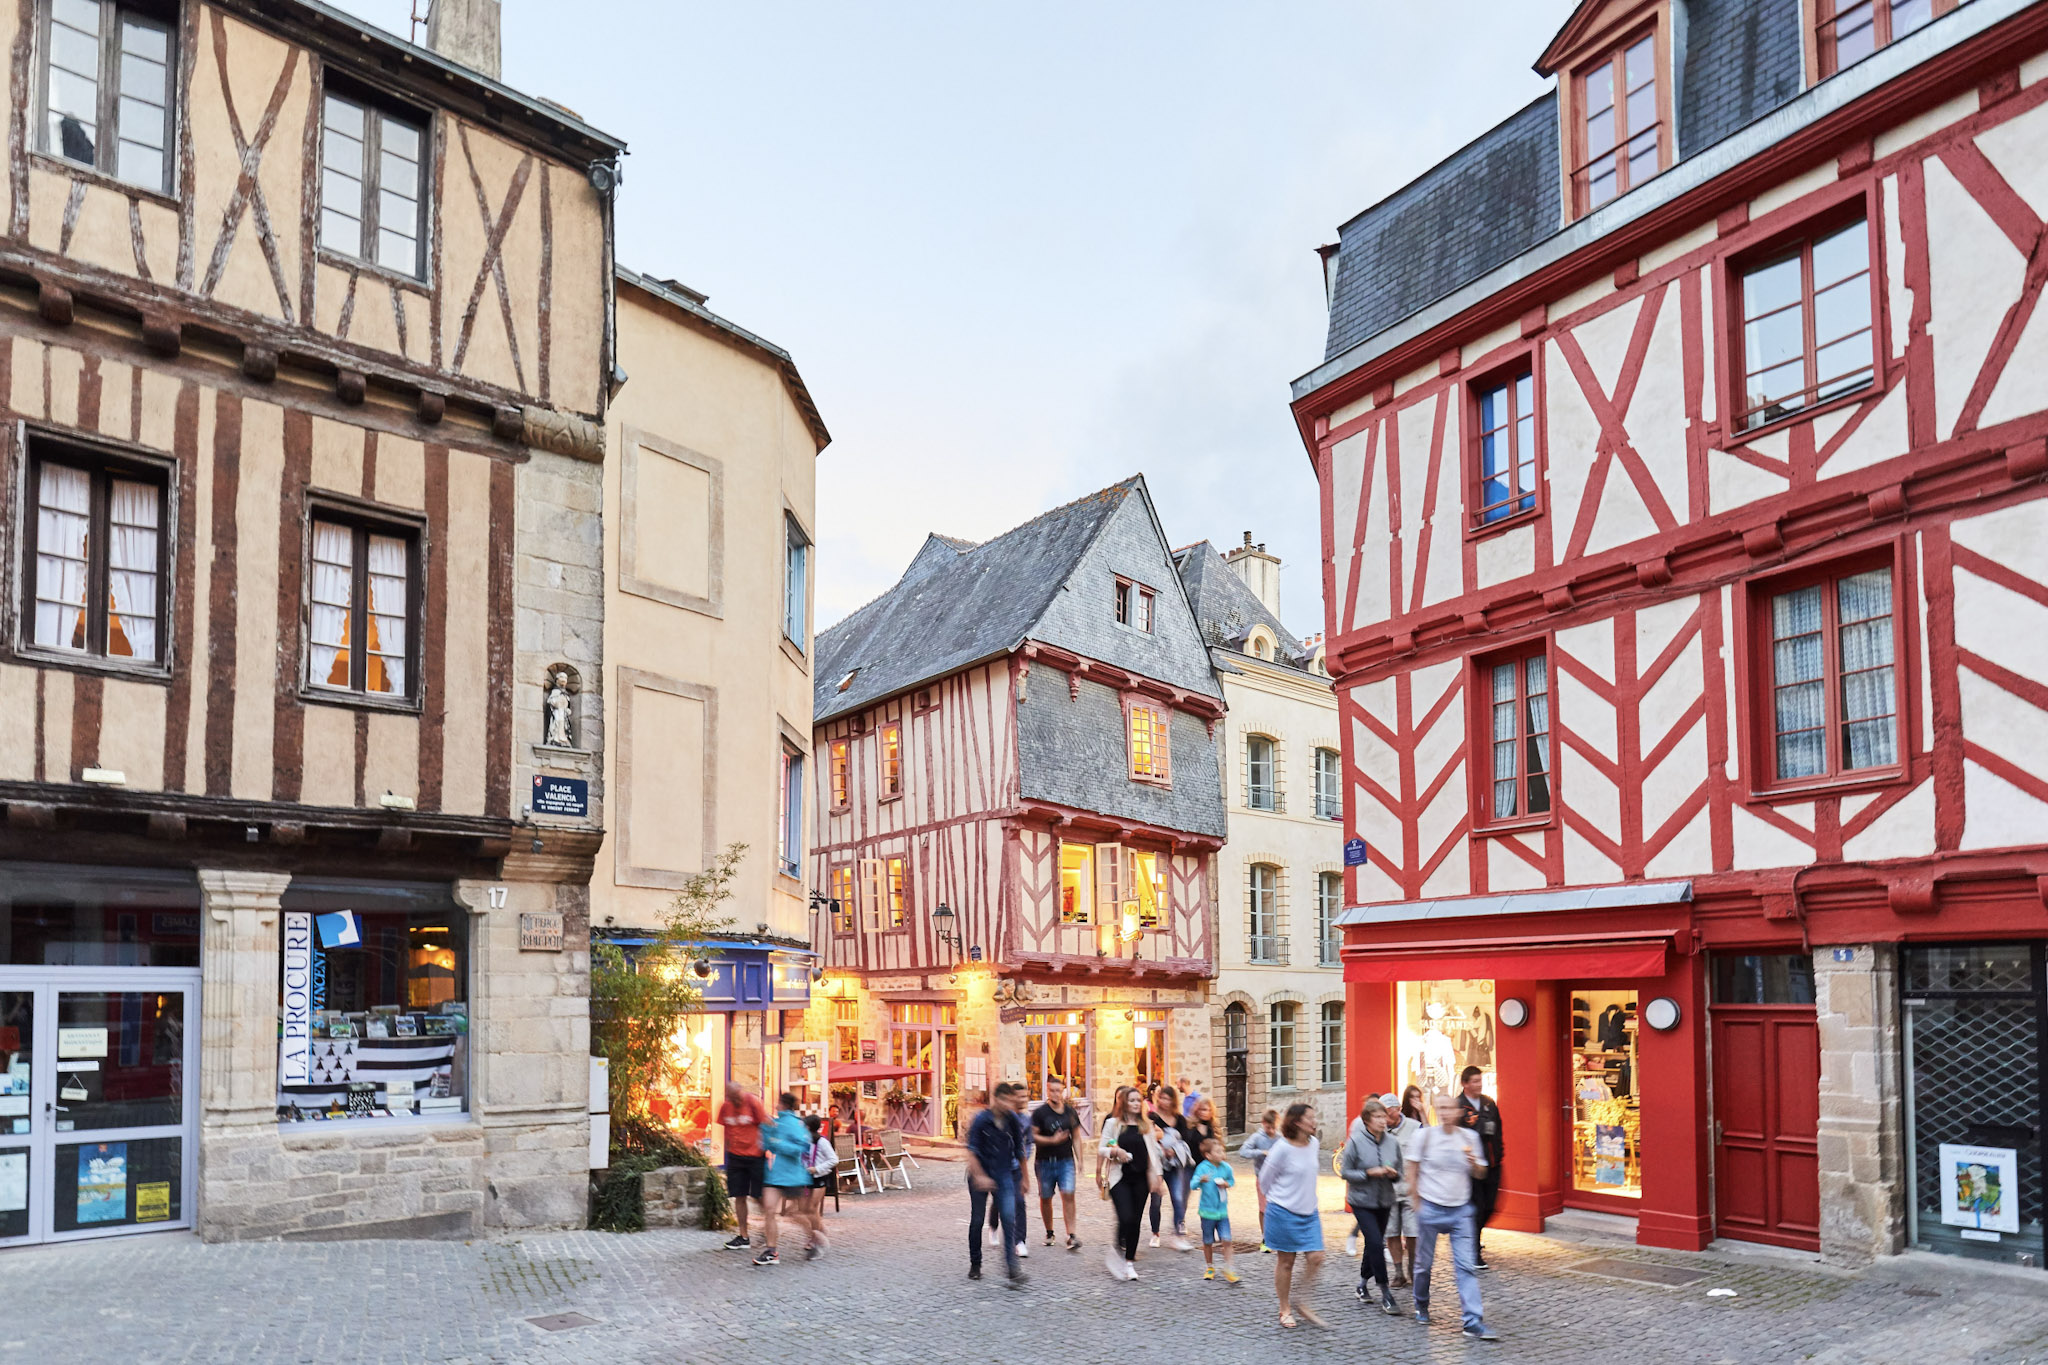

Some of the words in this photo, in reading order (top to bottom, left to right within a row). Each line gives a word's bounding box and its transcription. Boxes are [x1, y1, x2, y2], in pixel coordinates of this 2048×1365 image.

[545, 792, 576, 802] VALENCIA
[550, 784, 571, 793] PLACE
[488, 887, 508, 908] 17
[1839, 949, 1846, 961] 5
[286, 916, 308, 1039] PROCURE
[313, 948, 326, 1011] VINCENT
[286, 1050, 306, 1080] LA
